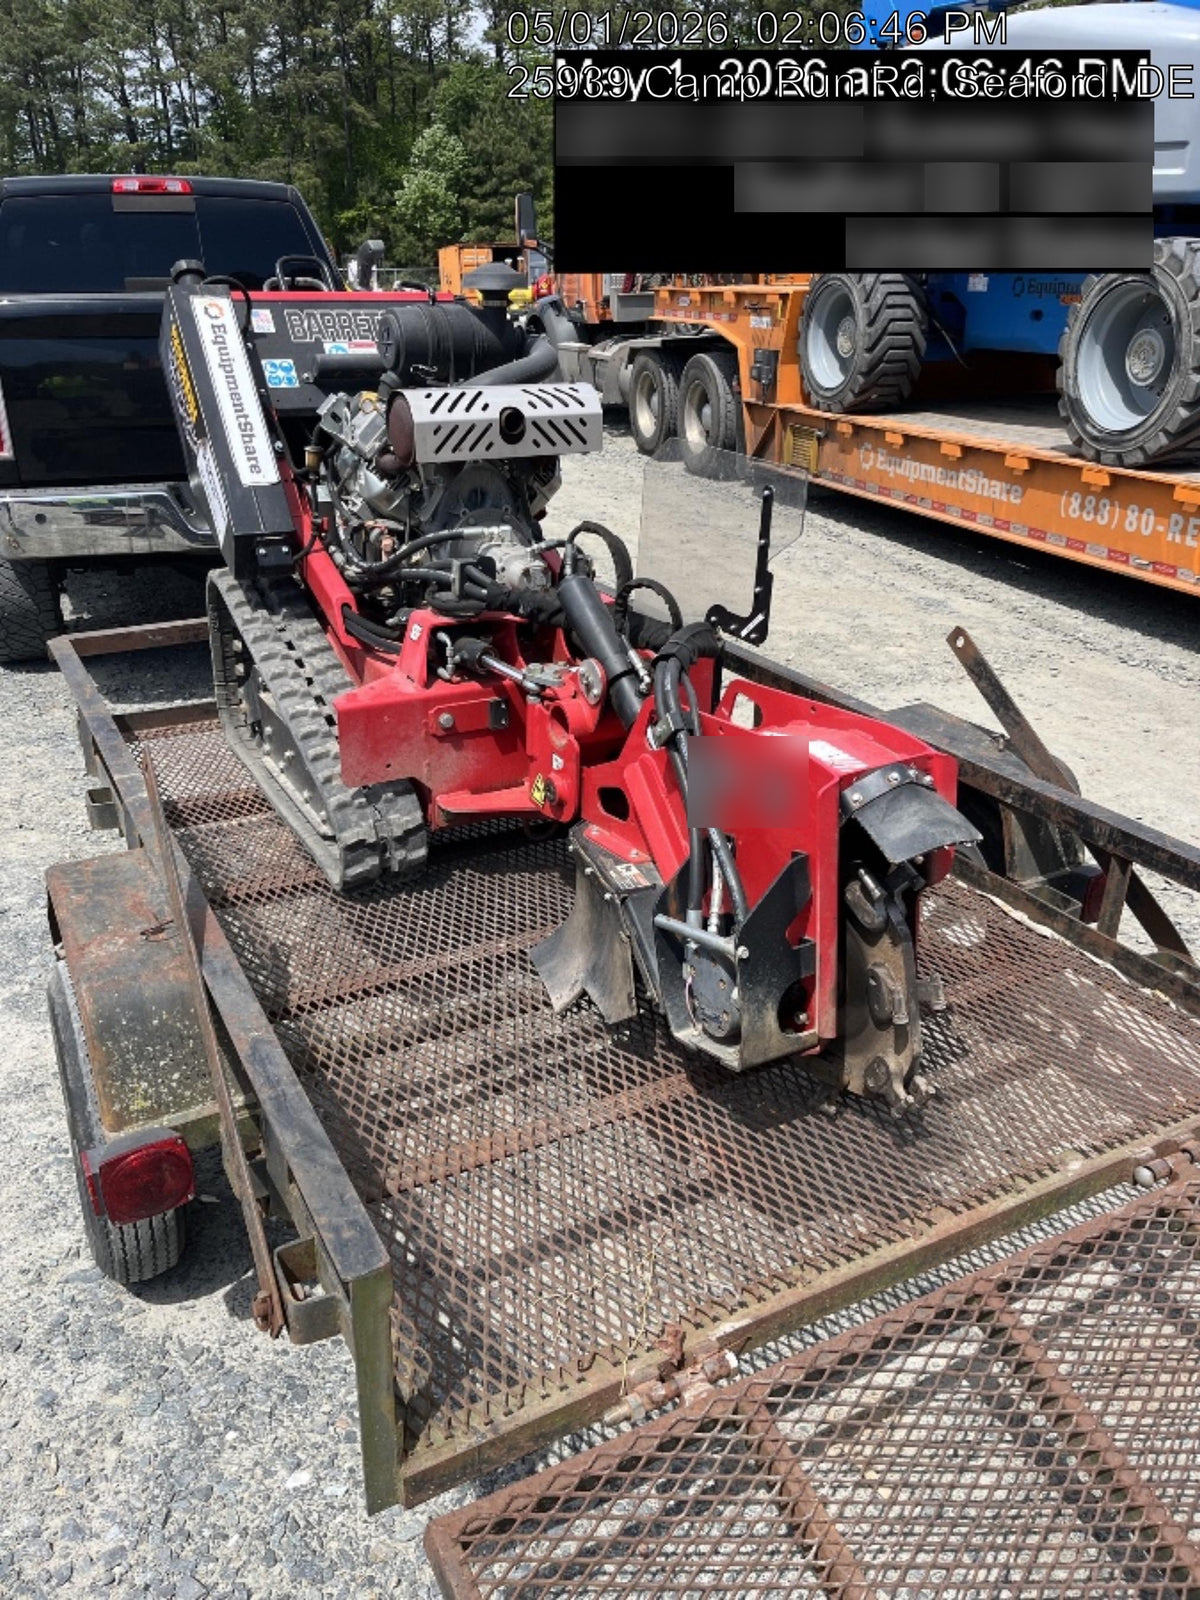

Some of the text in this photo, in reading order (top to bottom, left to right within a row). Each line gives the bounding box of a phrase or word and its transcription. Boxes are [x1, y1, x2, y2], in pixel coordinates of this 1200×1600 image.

[284, 309, 387, 342] BARRET
[210, 323, 261, 474] EquipmentShare
[876, 447, 1023, 504] EquipmentShare
[1060, 490, 1119, 529] (888)
